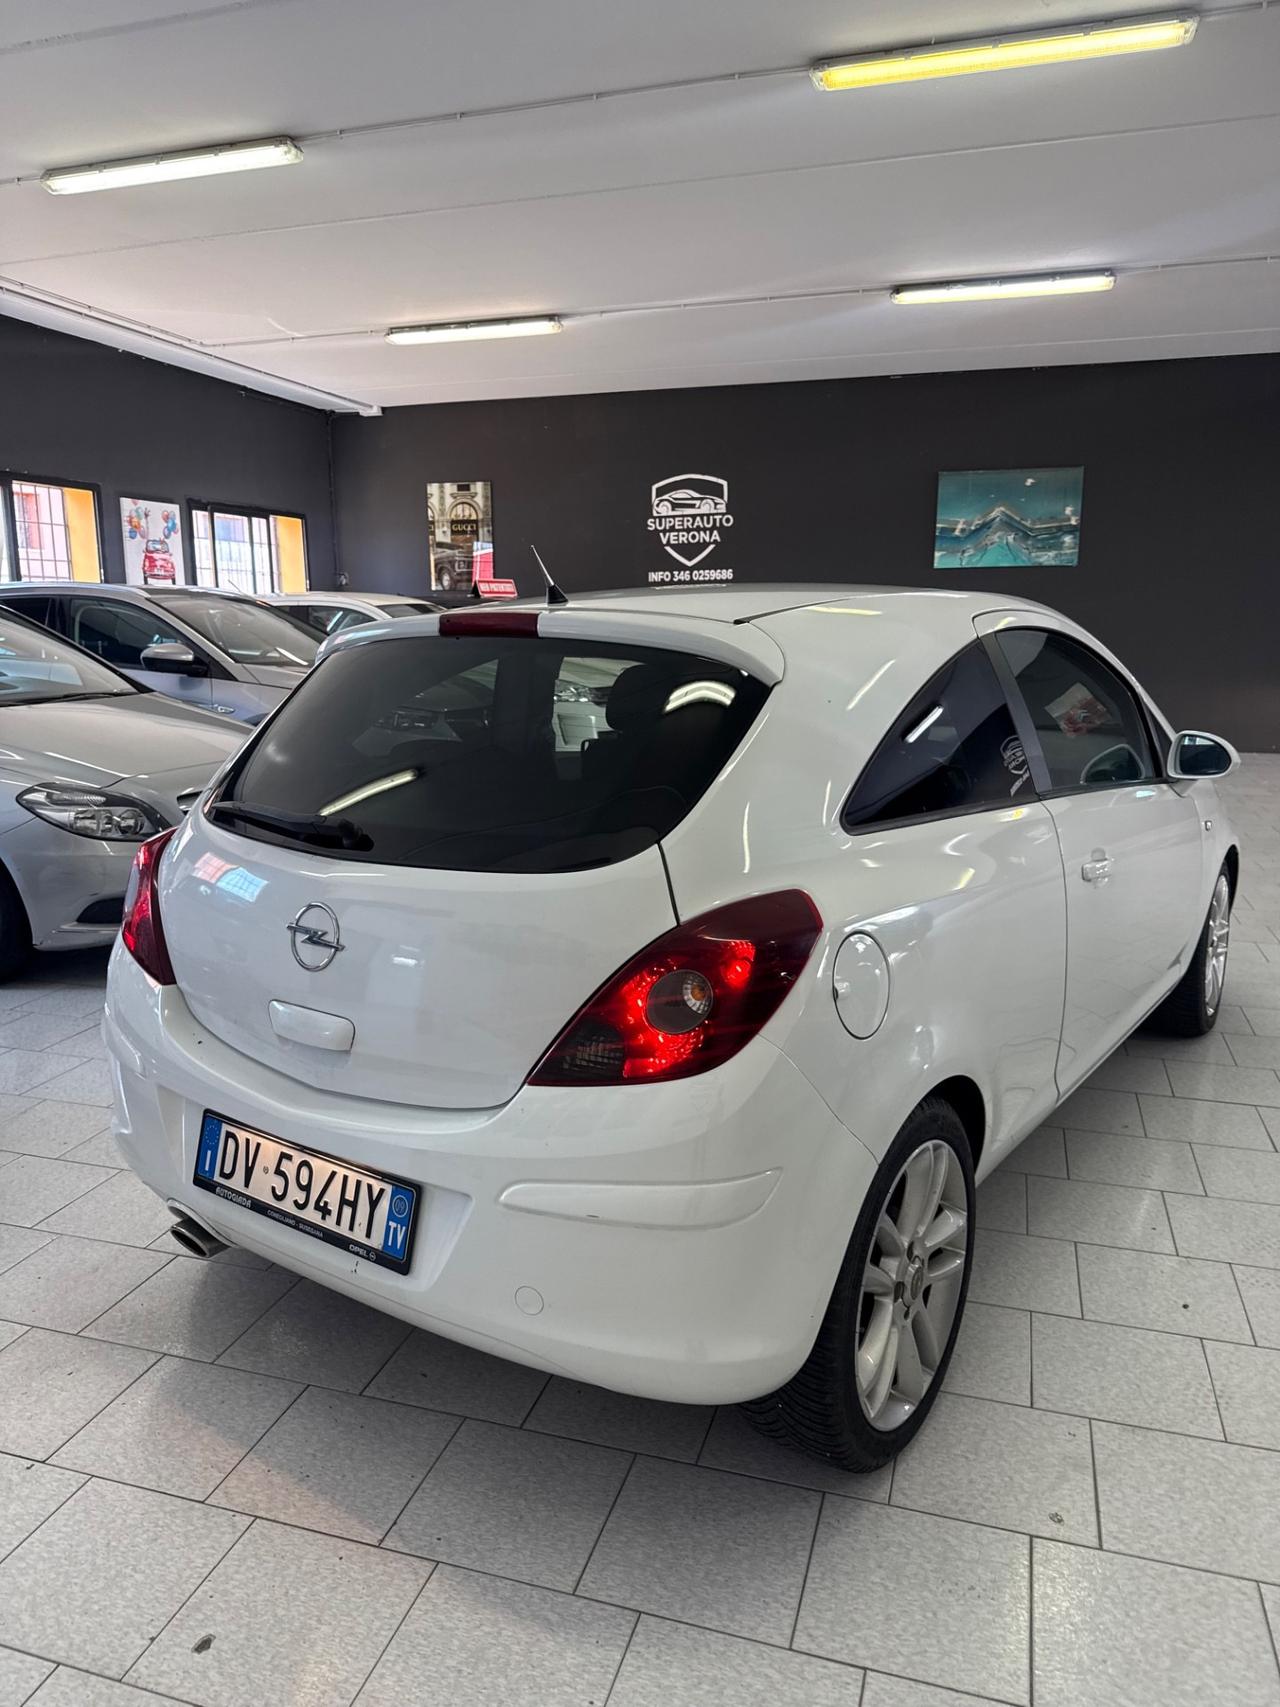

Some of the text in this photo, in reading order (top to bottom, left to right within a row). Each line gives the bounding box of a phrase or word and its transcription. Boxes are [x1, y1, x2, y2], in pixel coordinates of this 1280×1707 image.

[452, 523, 476, 531] GUCCI
[647, 514, 734, 531] SUPERAUTO
[659, 530, 721, 545] VERONA
[648, 569, 734, 582] INFO 346 0259686
[388, 1221, 407, 1250] TV
[348, 1244, 369, 1258] OPEL
